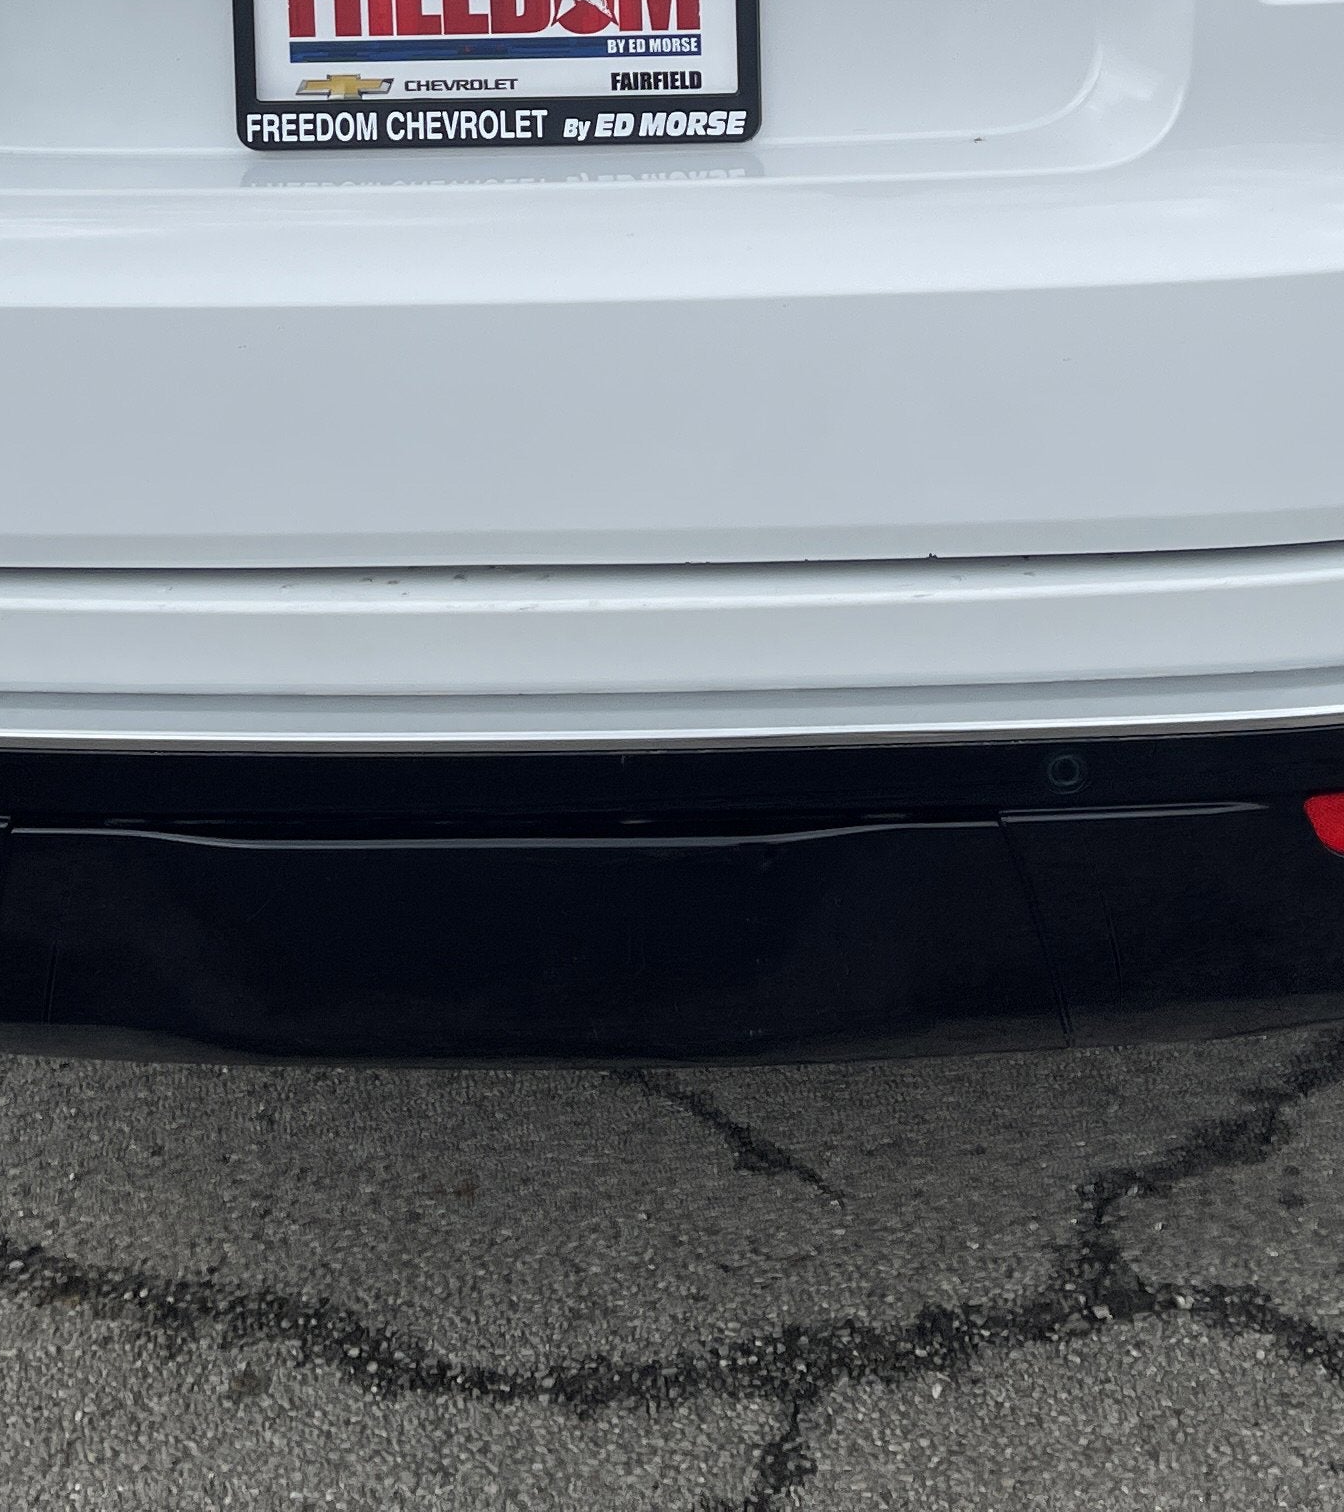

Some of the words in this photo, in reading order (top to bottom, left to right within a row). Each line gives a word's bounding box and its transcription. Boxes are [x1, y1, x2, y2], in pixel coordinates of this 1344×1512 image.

[607, 39, 626, 54] BY
[628, 38, 646, 53] ED
[649, 37, 699, 53] MORSE
[404, 78, 519, 92] CHEVROLET
[610, 70, 703, 91] FAIRFIELD
[246, 111, 378, 143] FREEDOM
[386, 108, 549, 140] CHEVROLET
[563, 118, 591, 141] By
[594, 112, 635, 138] ED
[638, 110, 747, 137] MORSE
